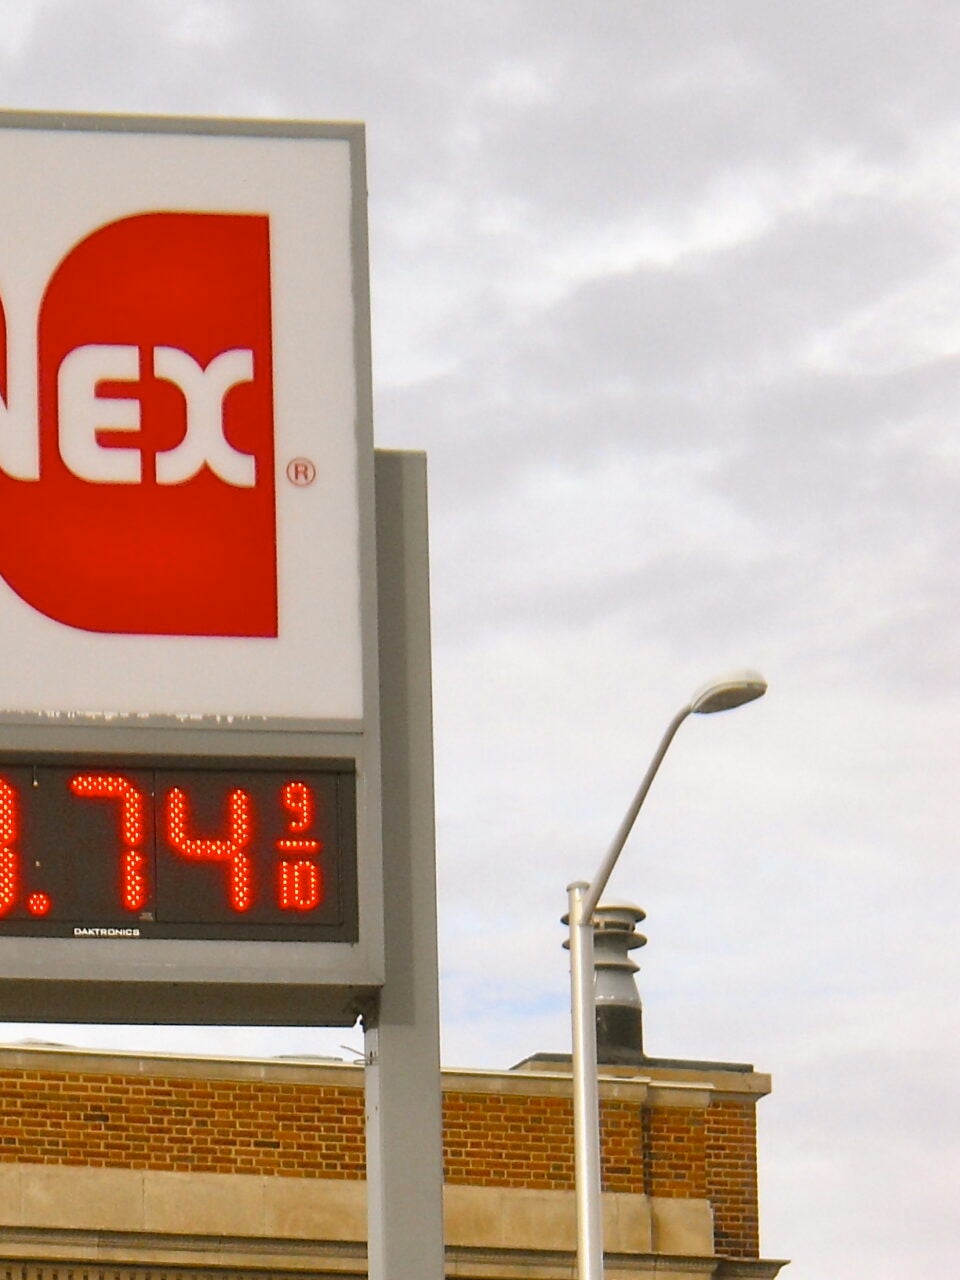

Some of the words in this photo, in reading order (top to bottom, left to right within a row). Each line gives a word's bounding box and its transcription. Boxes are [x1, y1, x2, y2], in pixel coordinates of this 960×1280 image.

[283, 780, 313, 832] 9
[279, 859, 320, 911] 10
[73, 927, 140, 937] DAKTRONICS
